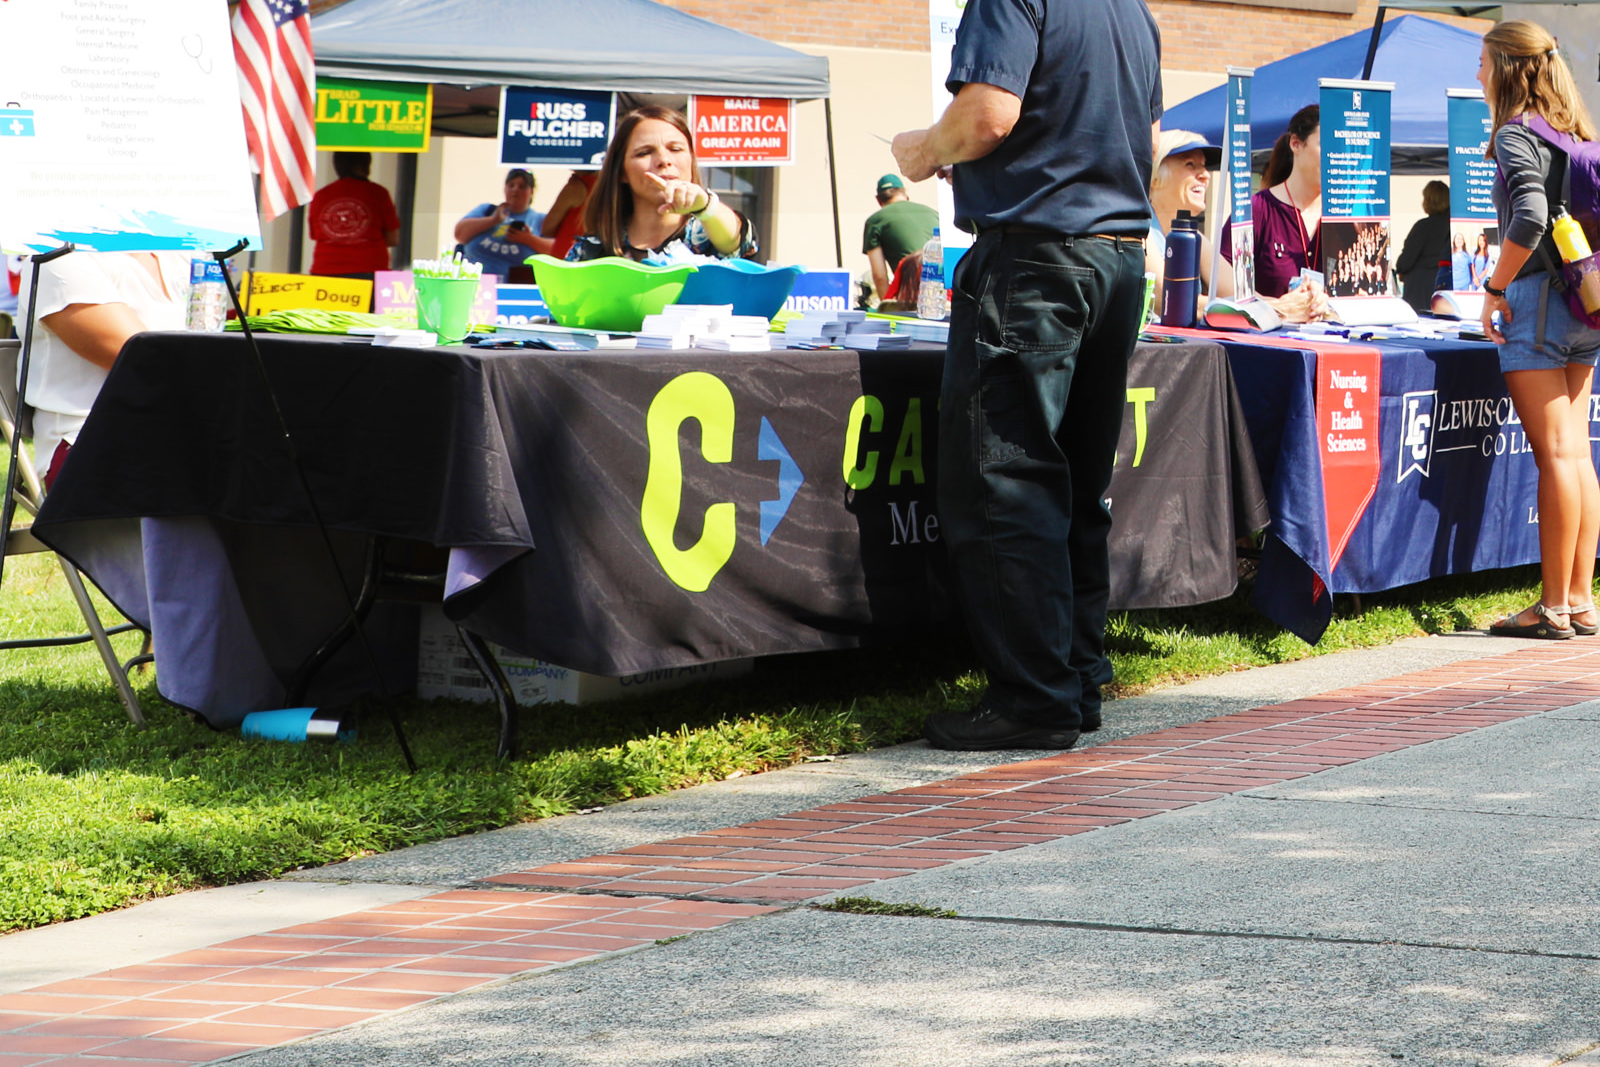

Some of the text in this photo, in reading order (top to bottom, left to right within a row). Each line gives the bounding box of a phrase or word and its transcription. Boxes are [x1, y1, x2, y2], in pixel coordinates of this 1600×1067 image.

[99, 0, 128, 10] Practice
[60, 11, 78, 21] Foot
[80, 13, 93, 22] and
[95, 14, 116, 23] Ankle
[75, 26, 105, 36] General
[75, 40, 139, 51] Internal Medicine
[88, 54, 130, 65] Laboratory
[121, 81, 155, 91] Medicine
[314, 88, 425, 124] LITTLE
[724, 98, 761, 110] MAKE
[530, 101, 587, 121] RUSS
[100, 120, 137, 130] Pediatrics
[507, 119, 606, 138] FULCHER
[696, 115, 787, 132] AMERICA
[529, 138, 583, 148] CONGRESS
[701, 137, 781, 149] GREAT AGAIN
[107, 147, 138, 158] Urology
[316, 288, 361, 307] Doug
[1329, 369, 1367, 393] Nursing
[1343, 391, 1354, 409] &
[1331, 410, 1362, 431] Health
[1327, 433, 1366, 453] Sciences
[507, 666, 568, 681] COMPANY
